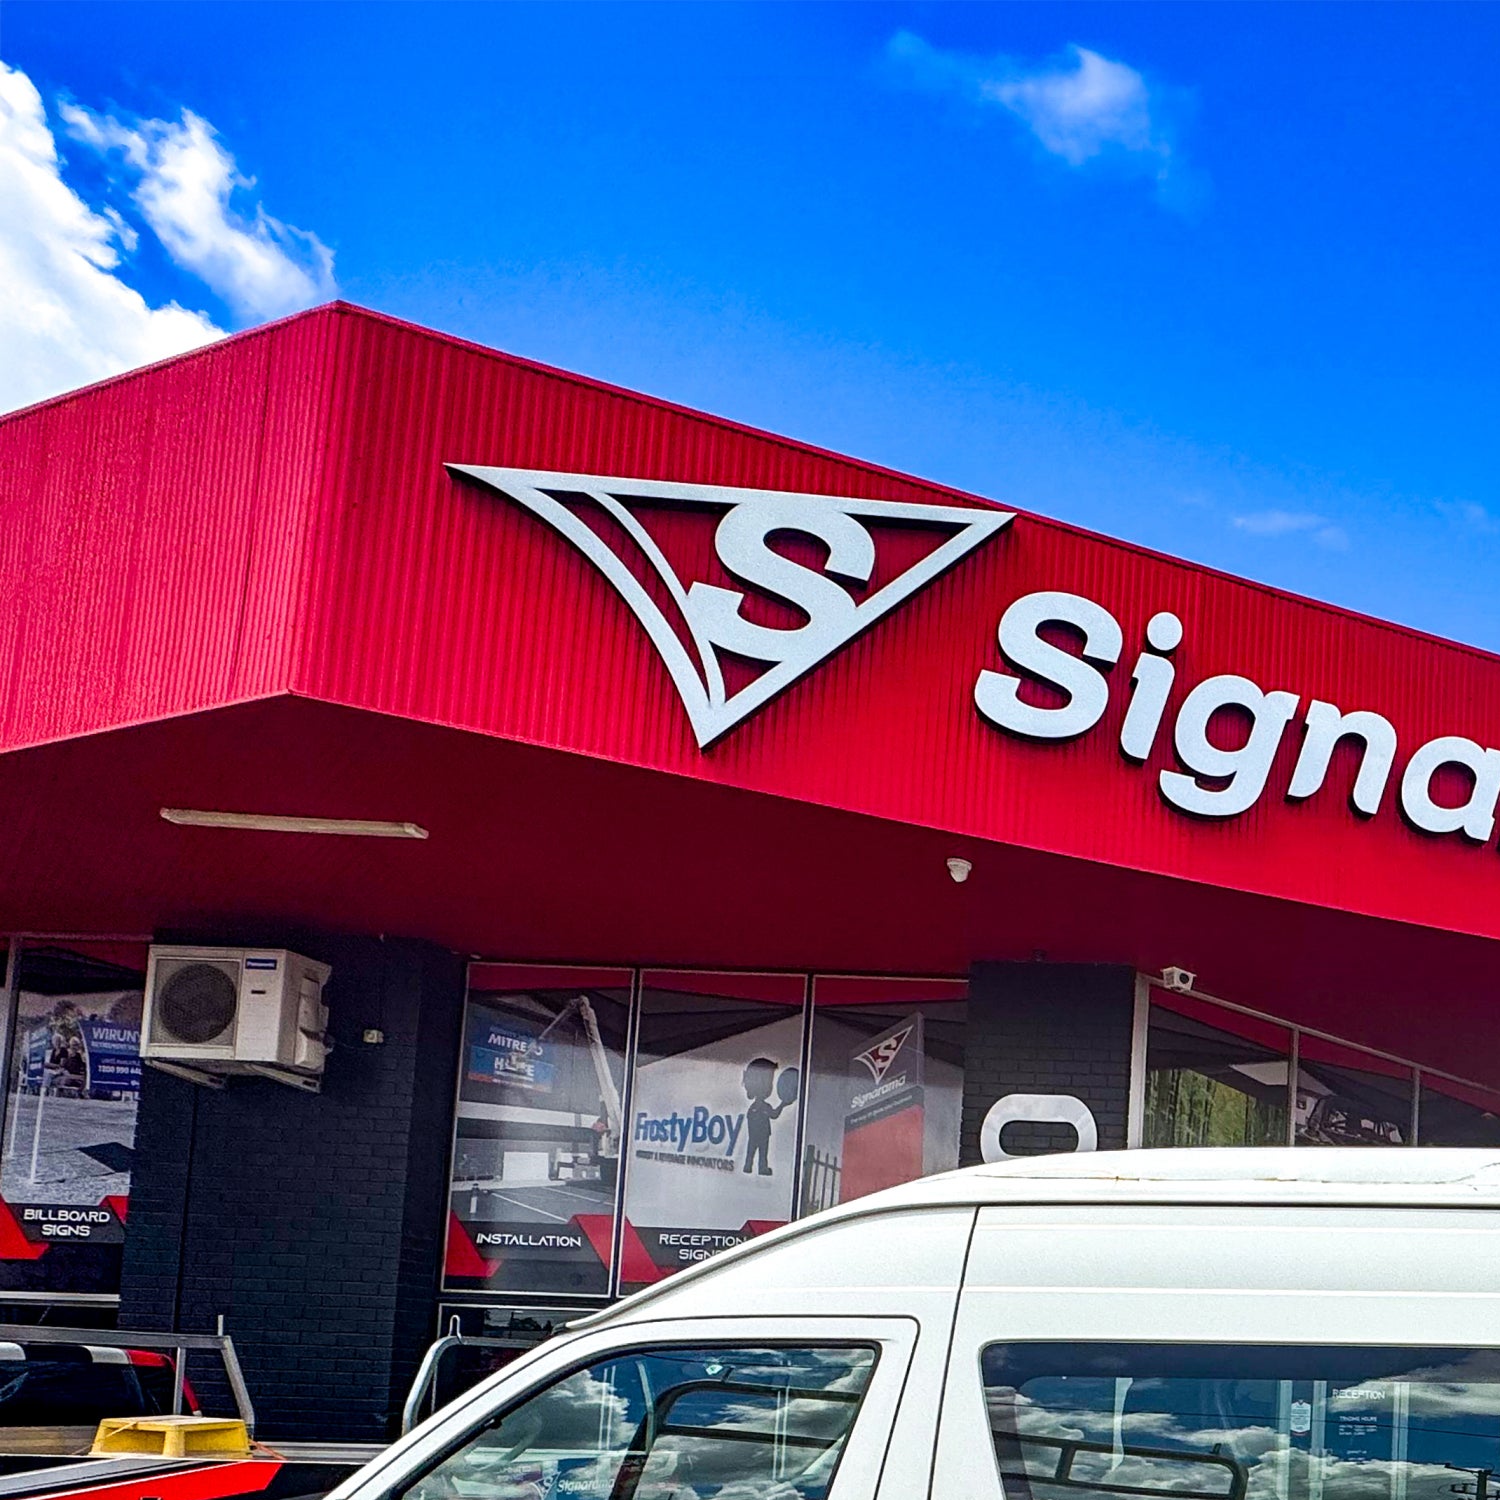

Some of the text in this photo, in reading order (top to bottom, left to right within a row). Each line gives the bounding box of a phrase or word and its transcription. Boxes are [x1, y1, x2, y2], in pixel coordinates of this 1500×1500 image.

[635, 1106, 745, 1157] FrostyBoy
[23, 1209, 110, 1222] BILLBOARD
[41, 1224, 91, 1237] SIGNS
[476, 1233, 582, 1247] INSTALLATION
[659, 1234, 747, 1247] RECEPTION
[1332, 1388, 1386, 1399] RECEPTION
